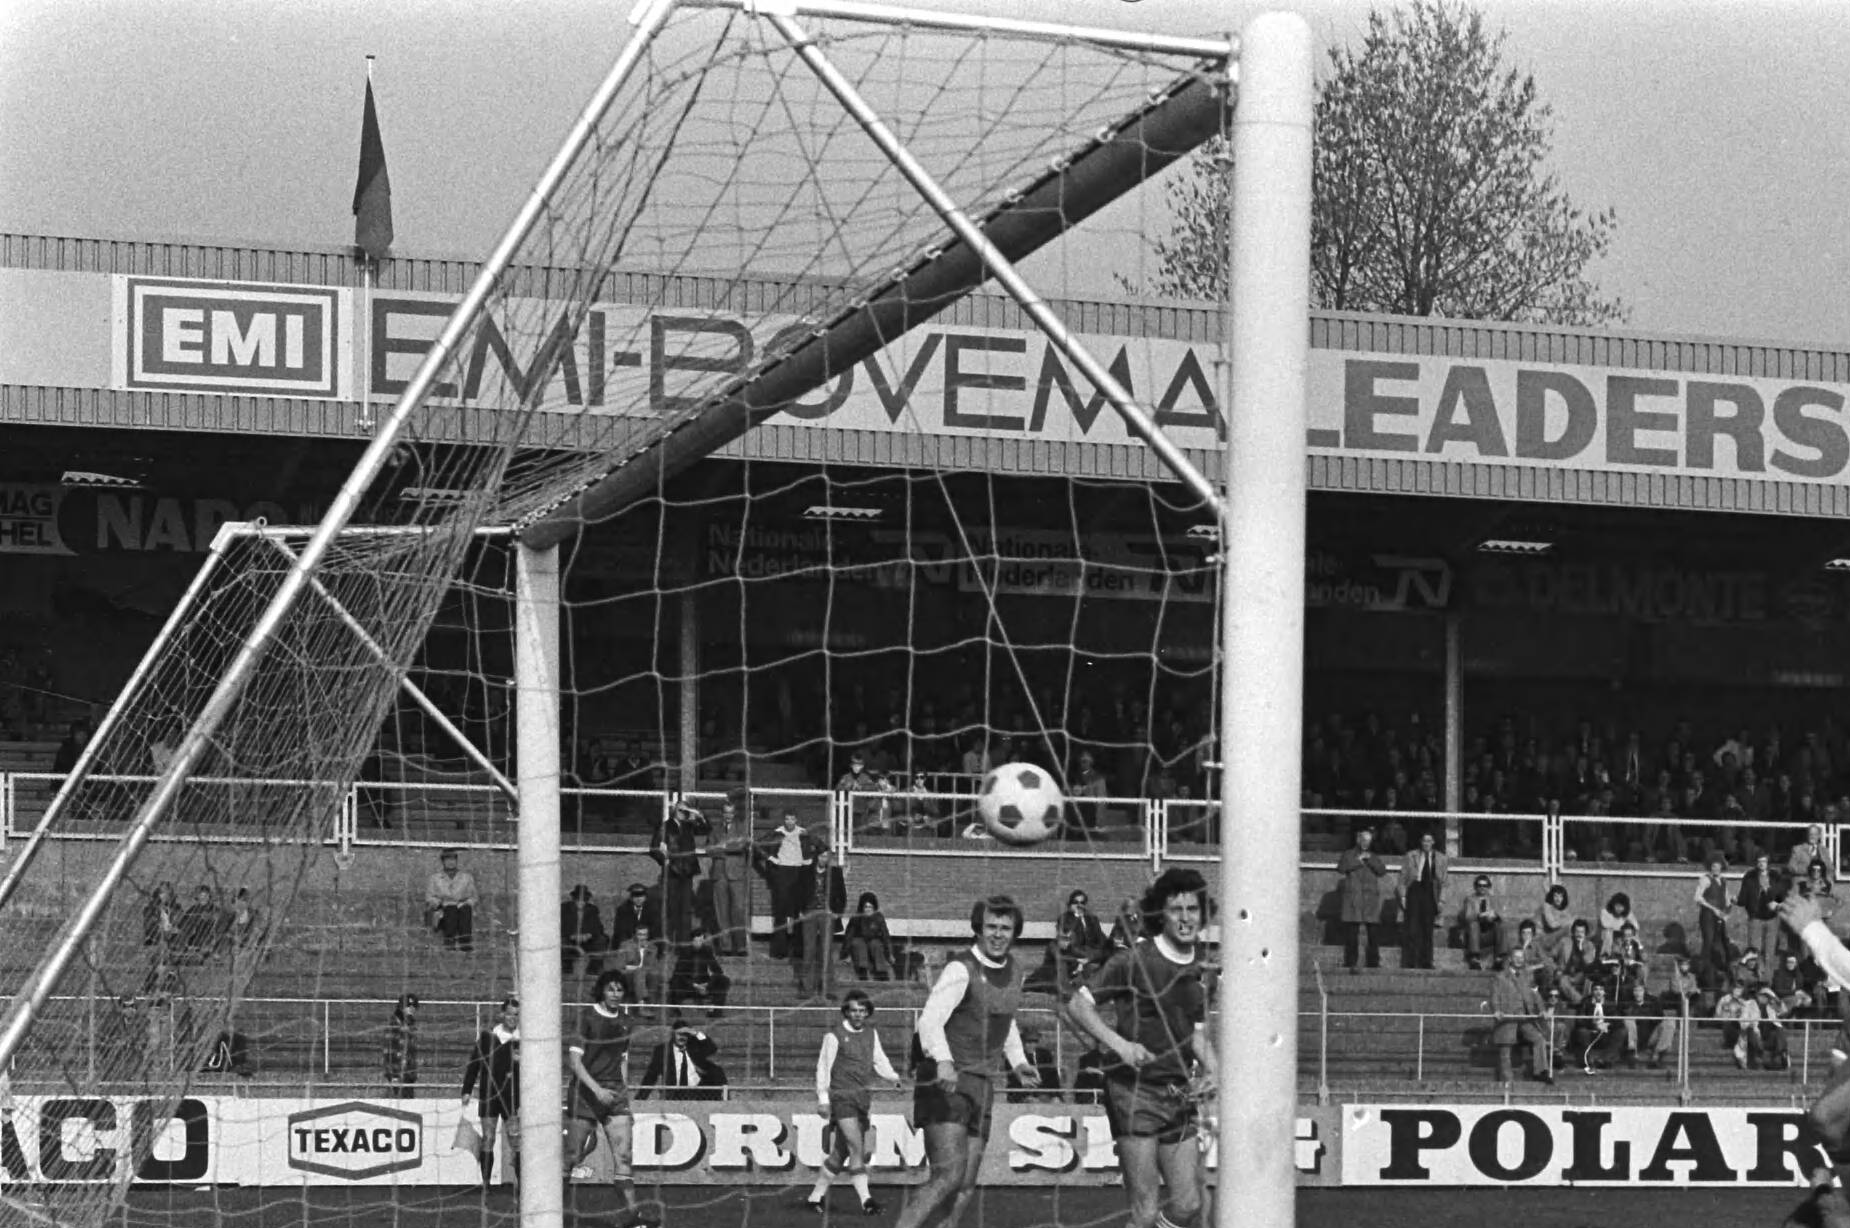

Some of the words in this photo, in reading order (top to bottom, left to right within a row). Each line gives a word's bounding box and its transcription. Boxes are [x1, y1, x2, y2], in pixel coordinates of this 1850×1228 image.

[162, 306, 304, 369] EMI
[1306, 357, 1850, 479] EADERS
[294, 1126, 417, 1154] TEXACO
